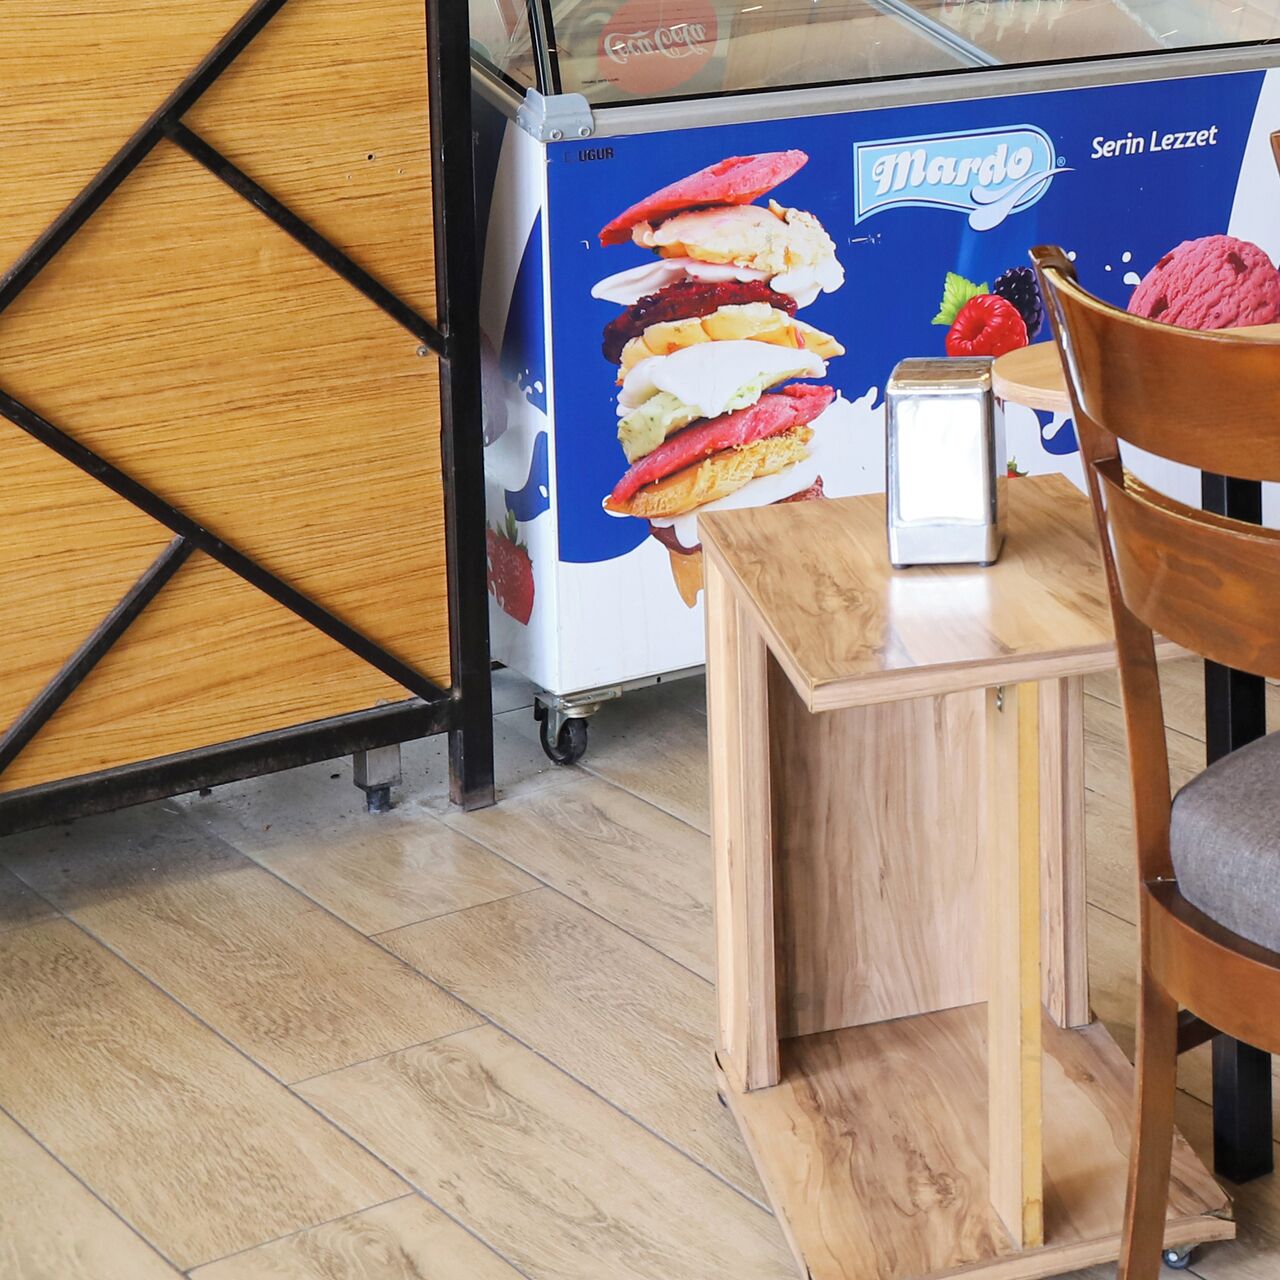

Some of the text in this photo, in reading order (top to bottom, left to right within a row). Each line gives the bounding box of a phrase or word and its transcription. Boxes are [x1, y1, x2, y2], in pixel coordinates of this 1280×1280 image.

[1091, 125, 1219, 159] Serin Lezzet
[872, 143, 1033, 197] Mardo
